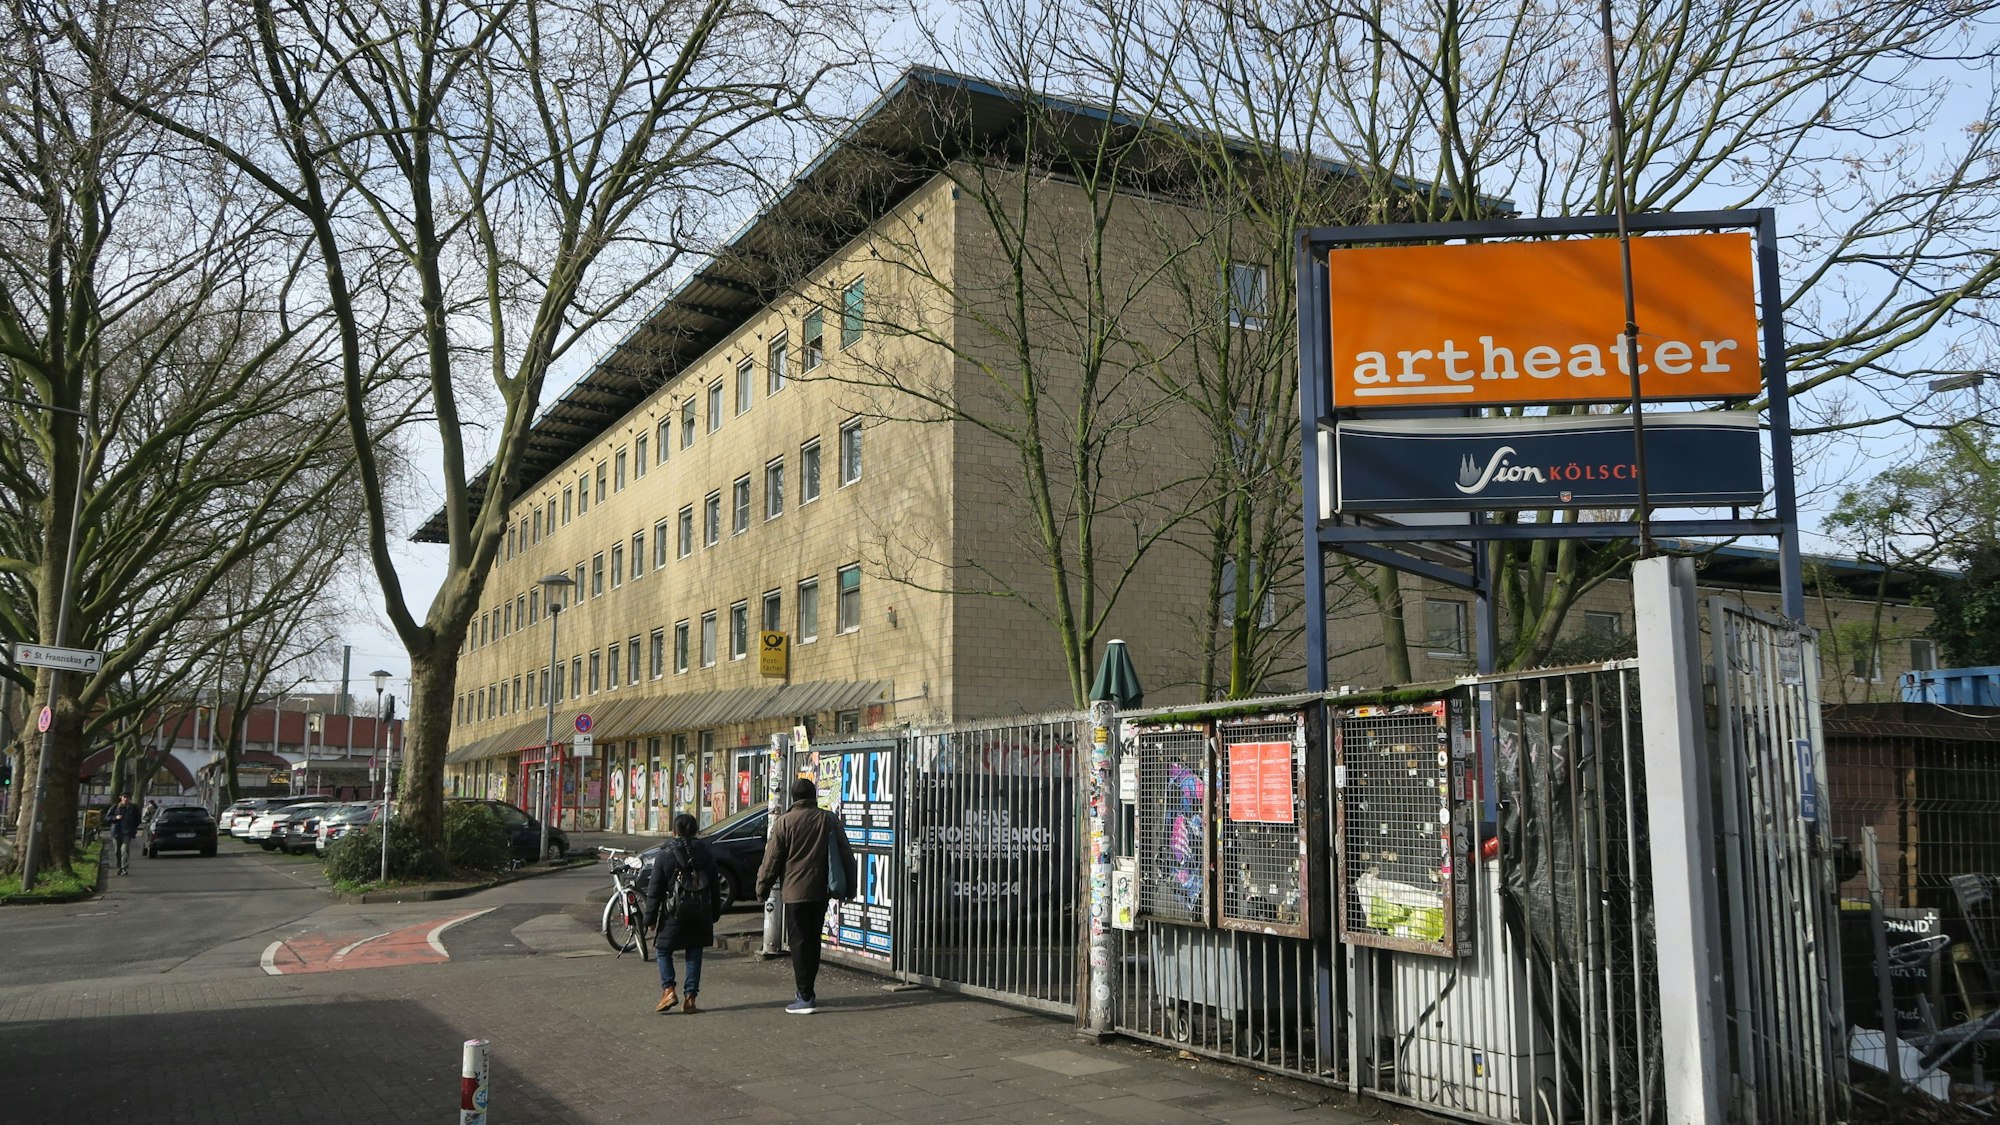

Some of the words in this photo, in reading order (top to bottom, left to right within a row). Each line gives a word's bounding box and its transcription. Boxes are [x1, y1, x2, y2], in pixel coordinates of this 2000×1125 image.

[1353, 333, 1738, 385] artheater
[1454, 446, 1547, 494] Sion
[45, 653, 82, 664] Franziskus
[842, 753, 866, 801] EXL
[869, 751, 893, 801] EXL
[965, 809, 1008, 826] DEAS
[992, 827, 1056, 843] SEARCH
[867, 853, 892, 907] EXL
